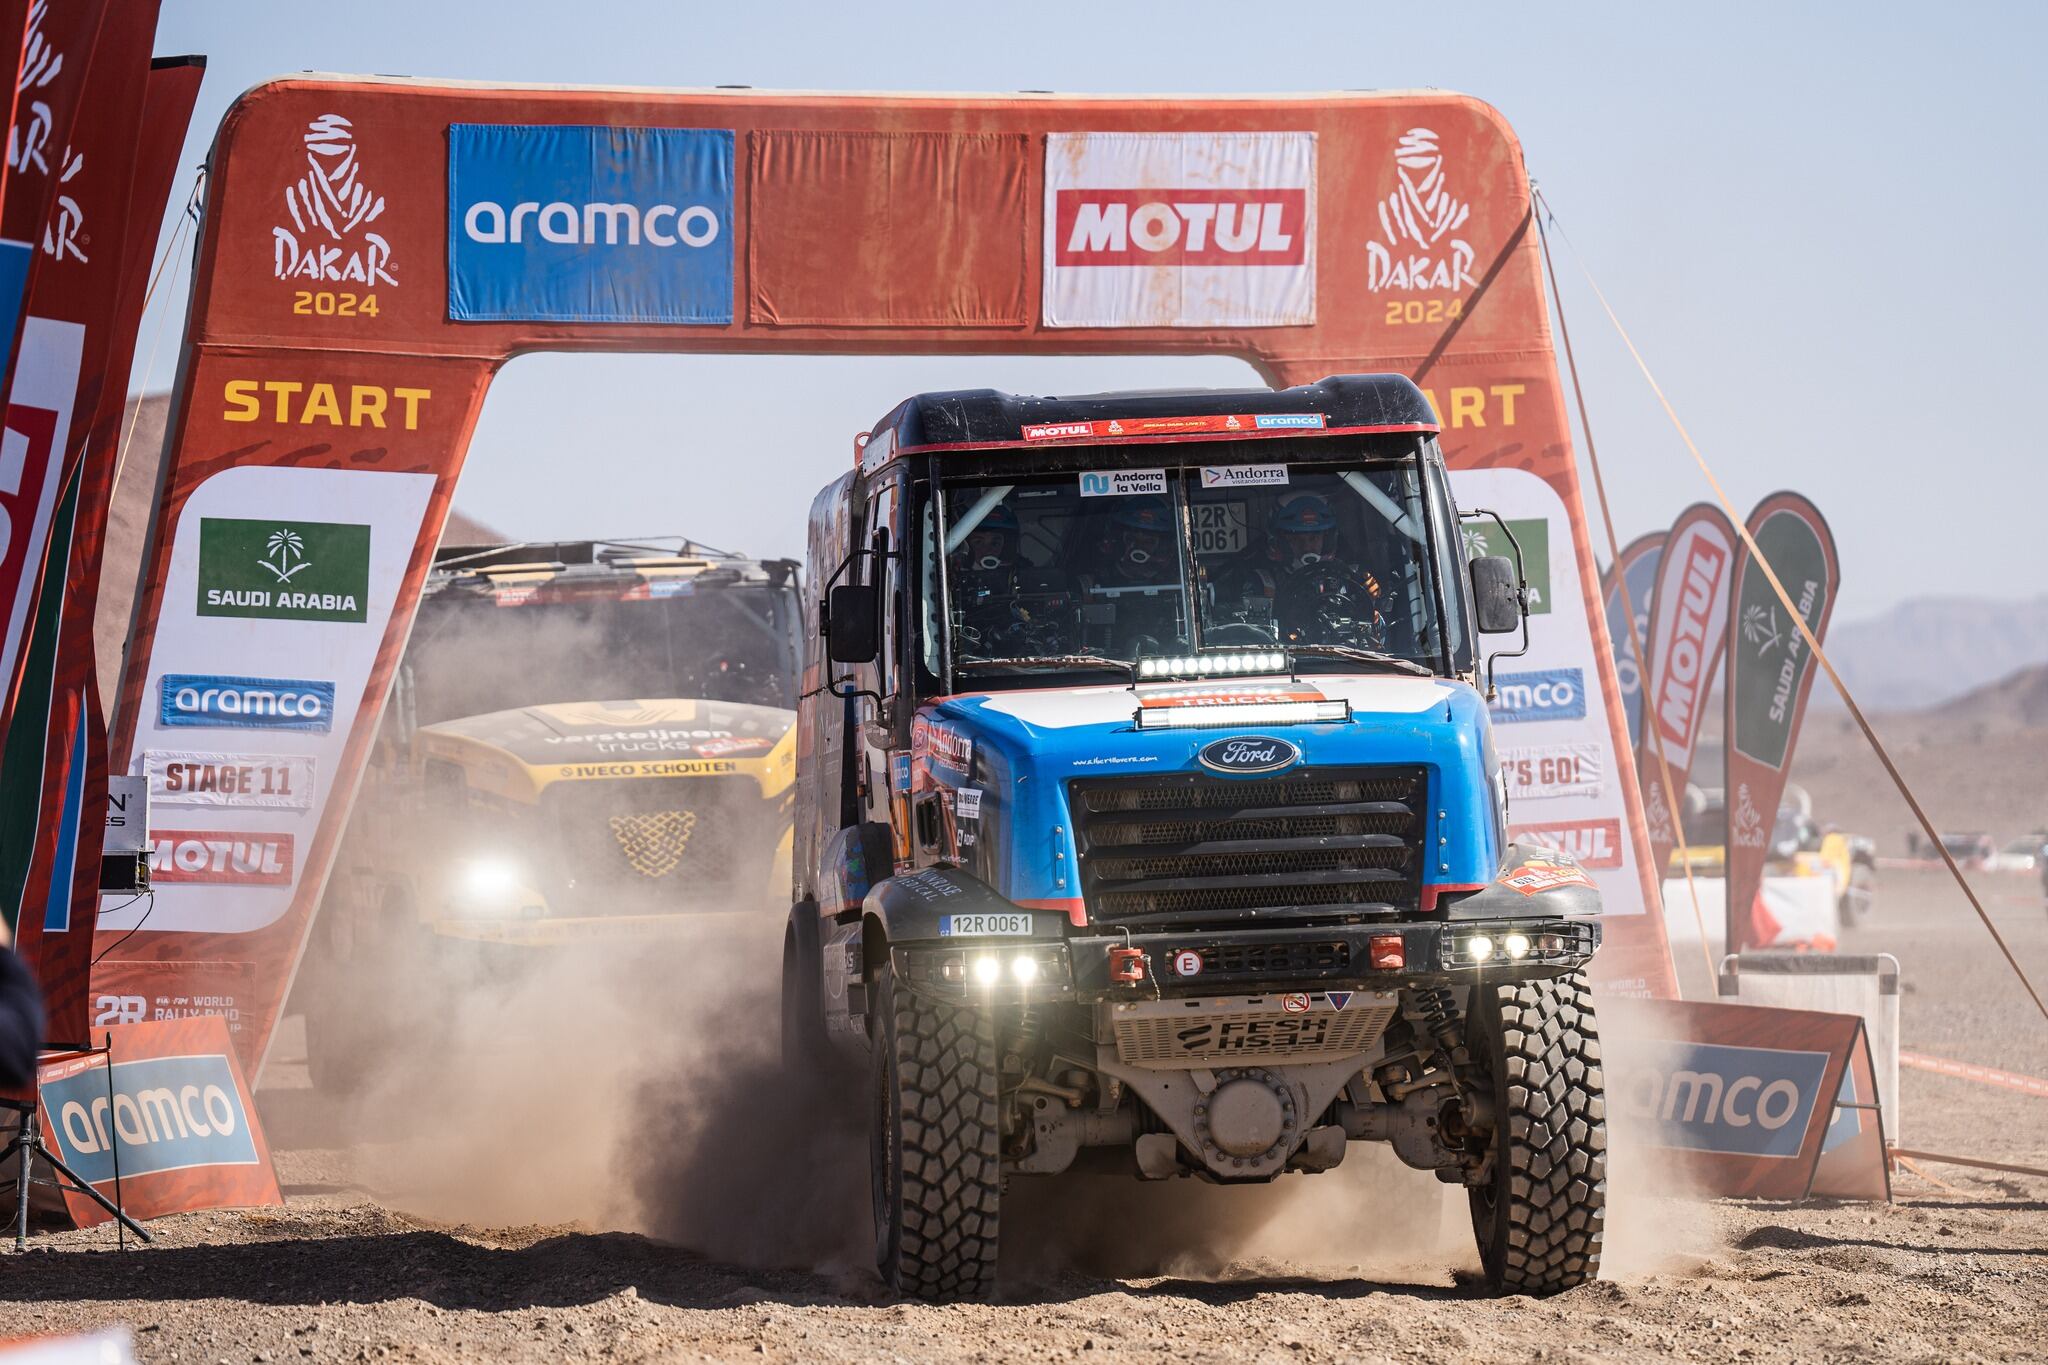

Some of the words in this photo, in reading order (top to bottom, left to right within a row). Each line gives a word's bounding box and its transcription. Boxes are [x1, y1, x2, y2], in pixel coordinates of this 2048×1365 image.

[464, 201, 720, 249] aramco
[1067, 202, 1293, 254] MOTUL
[272, 226, 399, 287] DAKAR
[1366, 239, 1481, 293] DAKAR
[293, 291, 380, 318] 2024
[1385, 299, 1464, 325] 2024
[223, 379, 432, 431] START
[1423, 384, 1526, 430] ART
[1030, 425, 1090, 437] MOTUL
[1260, 415, 1319, 426] aramco
[1113, 472, 1164, 483] Andorra
[1117, 483, 1131, 493] la
[1132, 482, 1162, 493] Vella
[1224, 468, 1285, 480] Andorra
[1231, 478, 1281, 486] visitandorra.com
[207, 589, 271, 608] SAUDI
[276, 591, 358, 612] ARABIA
[1660, 552, 1721, 738] MOTUL
[175, 687, 322, 719] aramco
[1492, 681, 1575, 710] mco
[1769, 659, 1796, 724] SAUDI
[596, 738, 691, 754] trucks
[1221, 741, 1276, 763] Ford
[165, 763, 253, 795] STAGE
[260, 766, 292, 796] 11
[576, 764, 635, 777] IVECO
[641, 761, 737, 775] SCHOUTEN
[1539, 757, 1581, 784] GO!
[148, 840, 284, 874] MOTUL
[1513, 827, 1614, 861] TUL
[953, 916, 985, 933] 12R
[987, 915, 1030, 933] 0061
[1183, 957, 1194, 971] E
[193, 996, 234, 1007] WORLD
[1220, 1018, 1328, 1036] FESH
[61, 1083, 236, 1155] aramco
